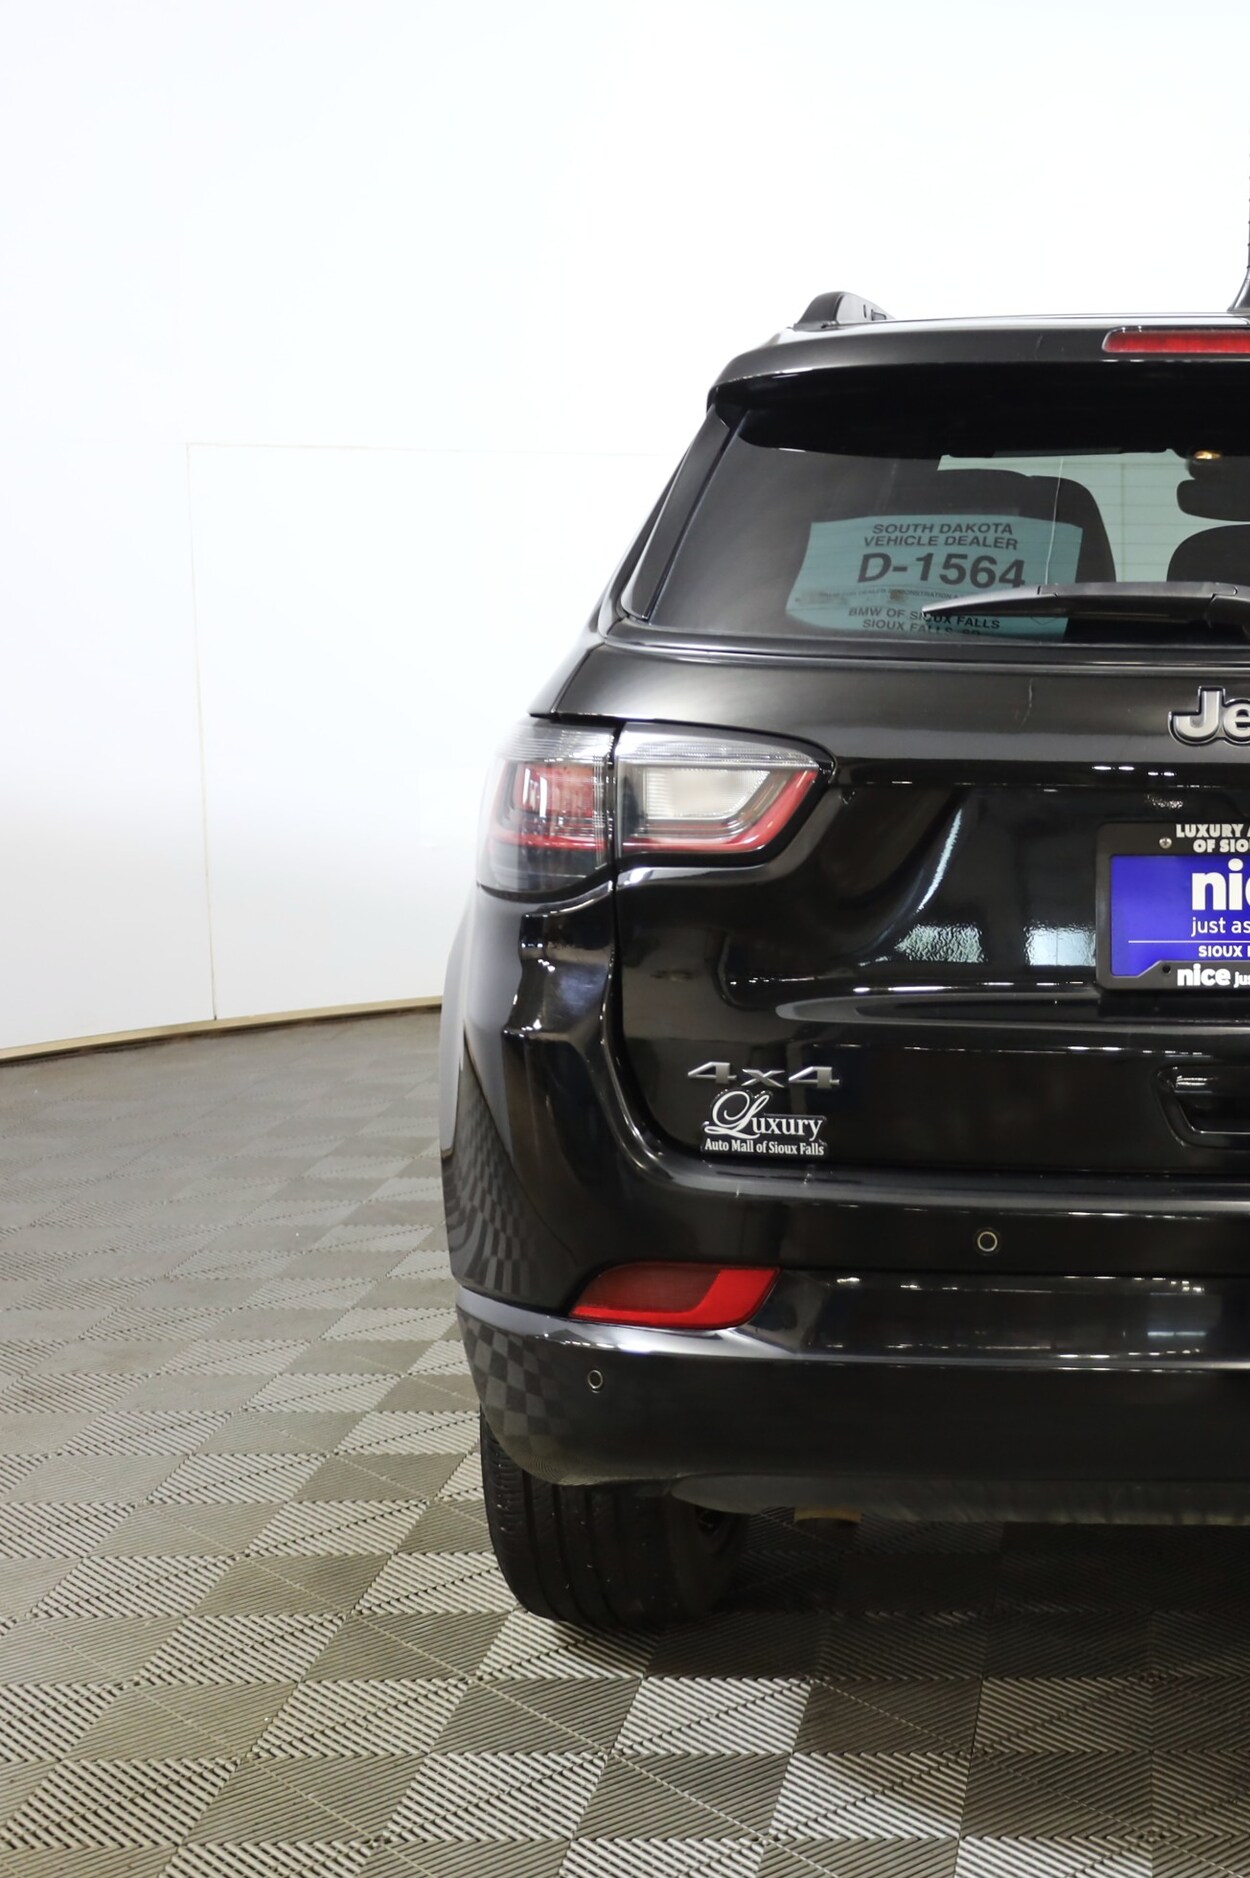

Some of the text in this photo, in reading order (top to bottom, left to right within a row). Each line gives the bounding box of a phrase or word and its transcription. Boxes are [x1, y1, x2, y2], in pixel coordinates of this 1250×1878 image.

[872, 523, 1013, 535] SOUTH DAKOTA
[863, 535, 1018, 550] VEHICLE DEALER
[857, 552, 1026, 589] D-1564
[848, 607, 882, 617] BMW
[886, 608, 906, 618] OF
[957, 615, 1000, 629] FALLS
[862, 618, 905, 631] SIOUX
[1176, 823, 1245, 838] LUXURY
[1193, 838, 1218, 853] OF
[1191, 917, 1226, 937] just
[1198, 945, 1243, 958] SIOUX
[1177, 963, 1232, 987] nice
[688, 1061, 840, 1089] 4x4
[704, 1090, 823, 1141] Luxury
[705, 1138, 825, 1156] Auto Mall of Sioux Falls
